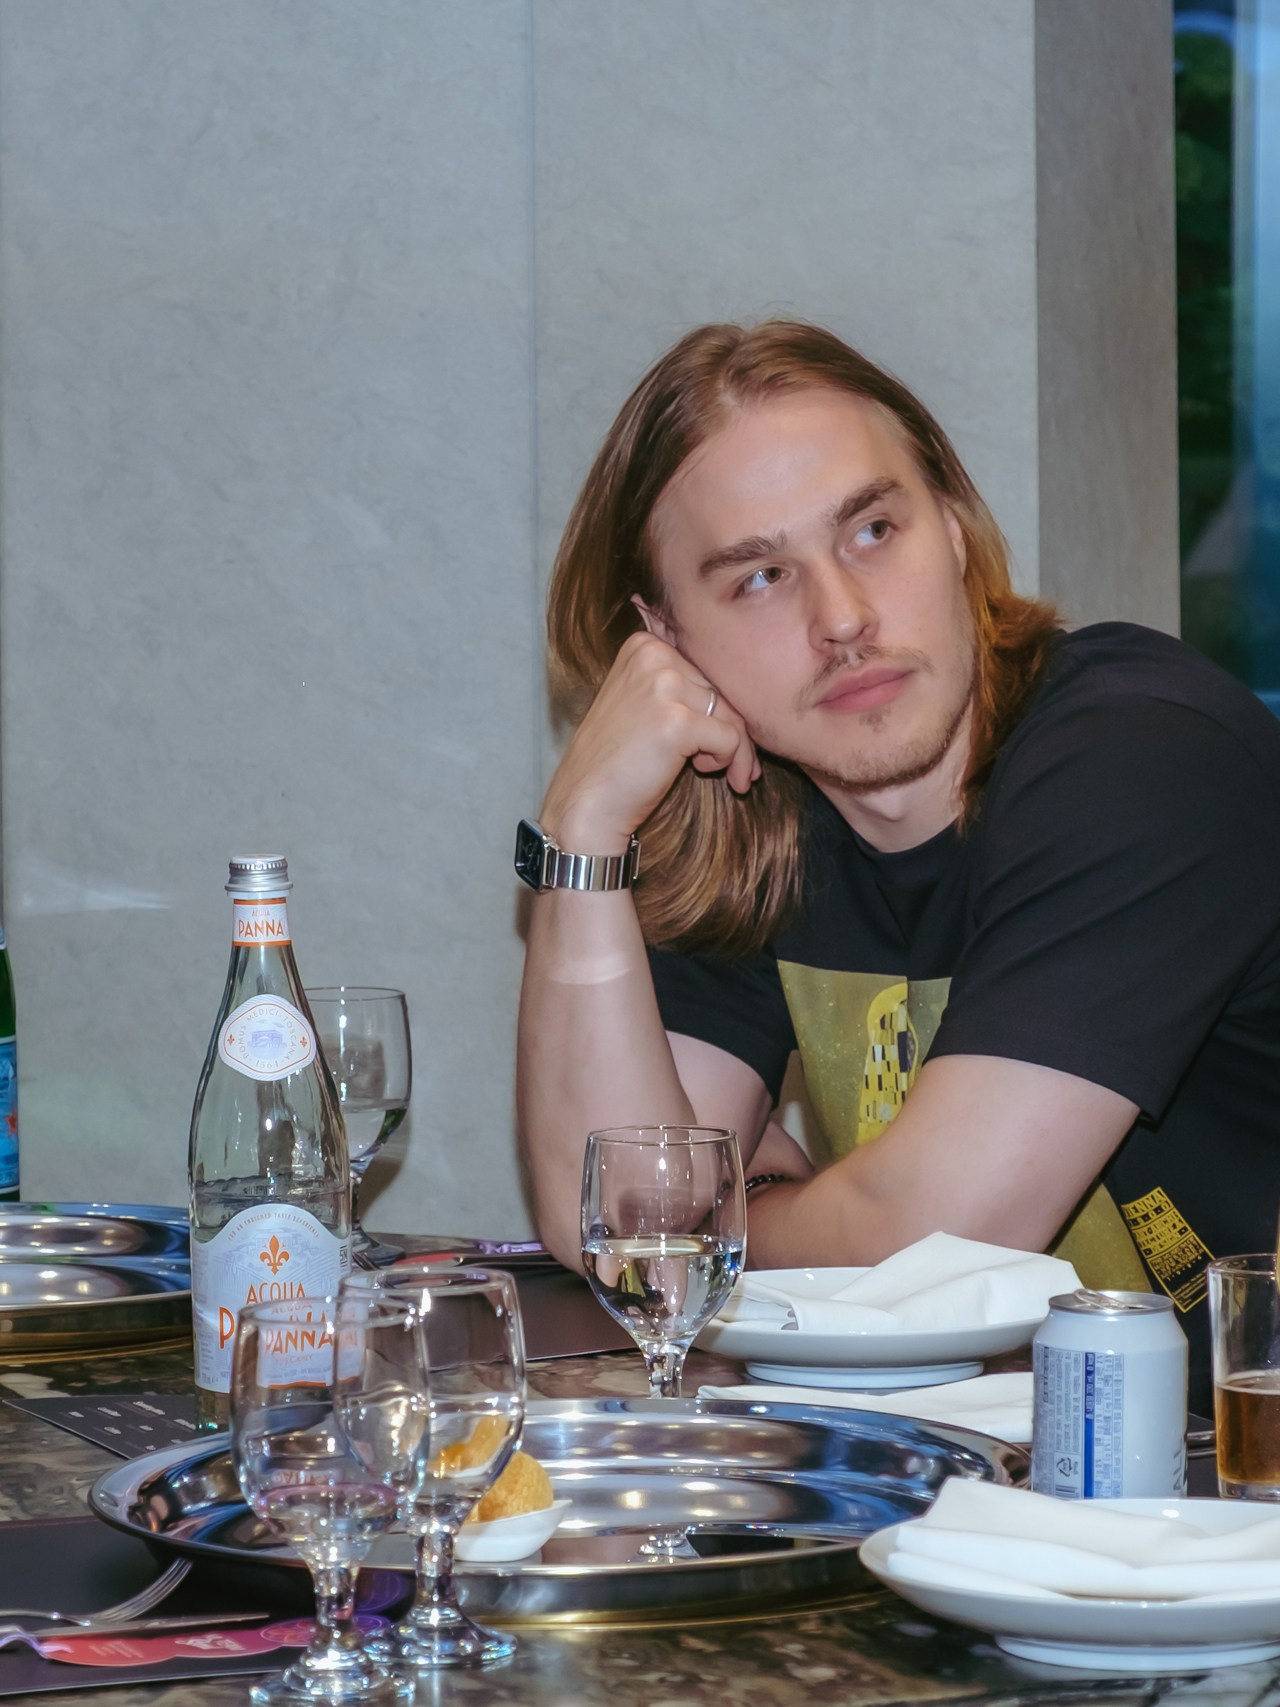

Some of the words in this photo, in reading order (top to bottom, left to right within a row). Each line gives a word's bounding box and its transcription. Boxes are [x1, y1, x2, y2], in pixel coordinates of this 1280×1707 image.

[238, 919, 285, 938] PANNA
[238, 1025, 250, 1060] DOMUS
[246, 1008, 279, 1022] MEDICI
[283, 1016, 297, 1060] TOSCANA
[246, 1281, 307, 1305] ACQUA
[265, 1328, 334, 1355] PANNA
